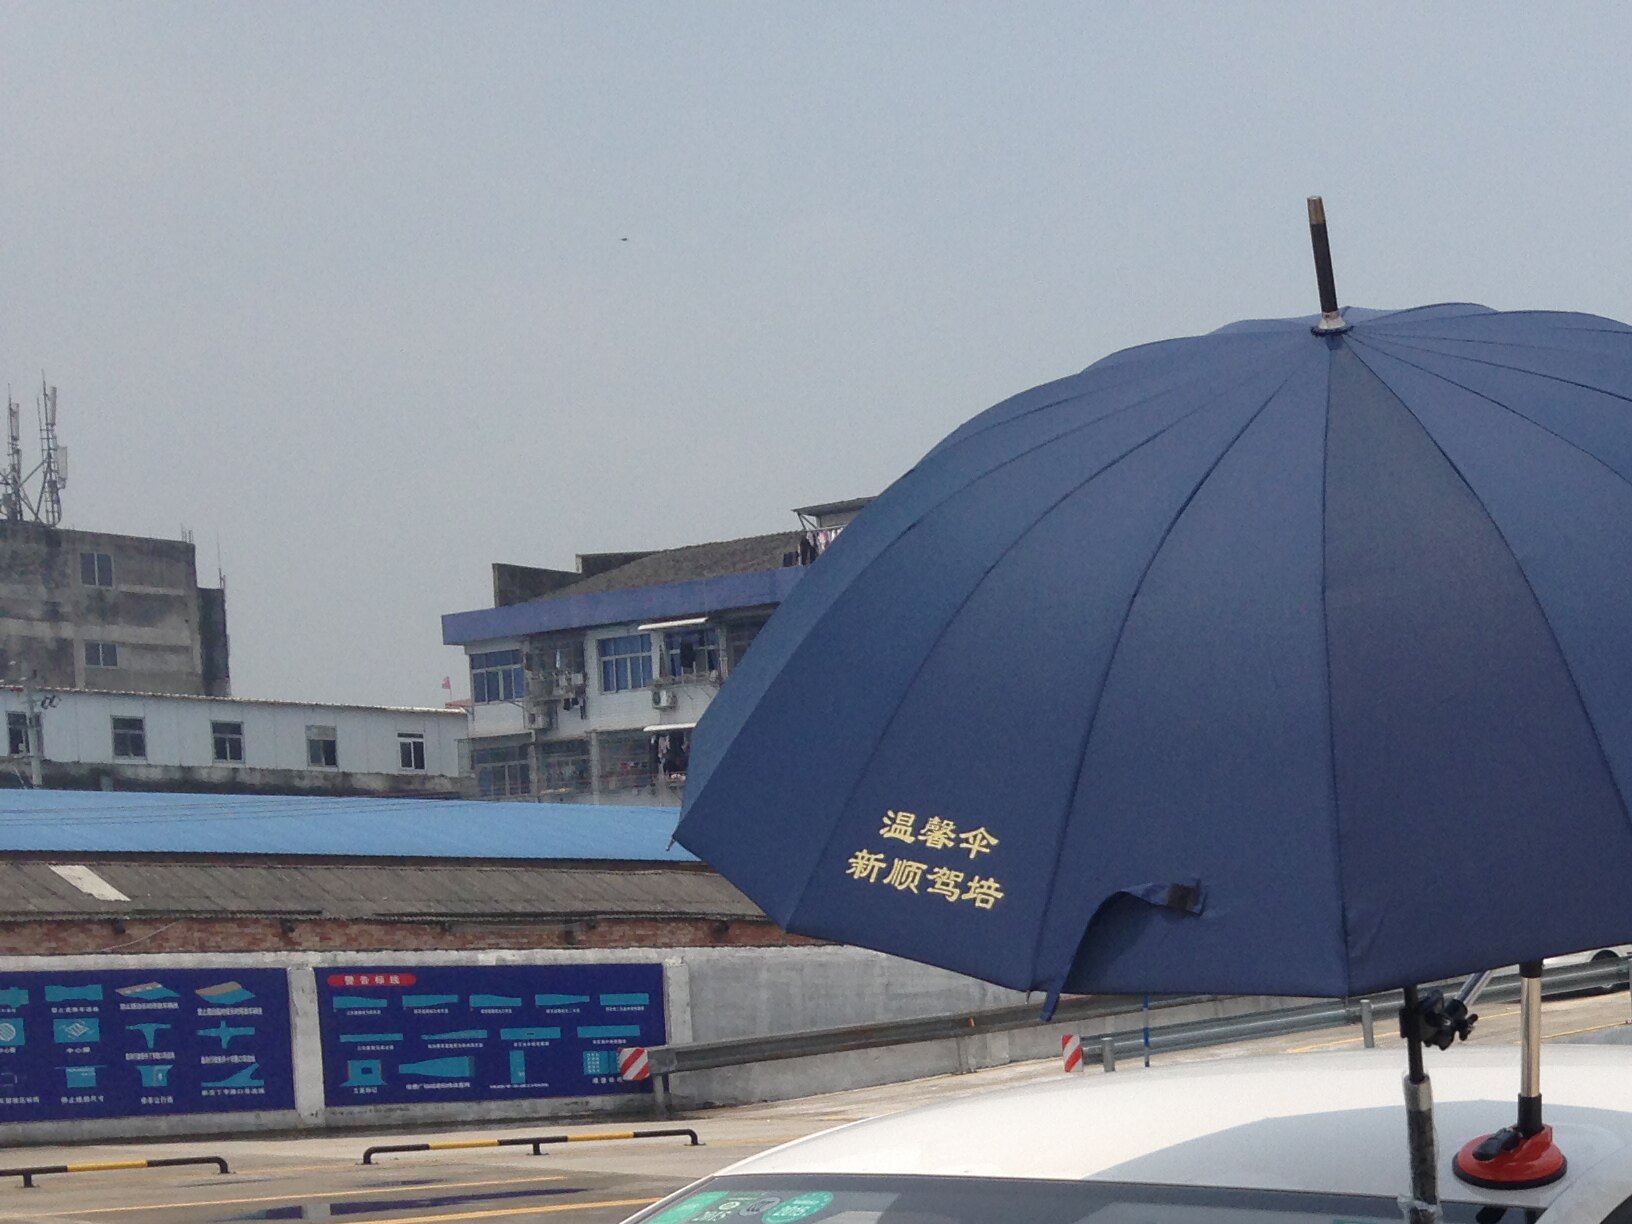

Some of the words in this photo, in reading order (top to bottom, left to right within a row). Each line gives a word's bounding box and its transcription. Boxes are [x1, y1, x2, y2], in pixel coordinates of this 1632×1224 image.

[878, 809, 1000, 859] 温馨伞
[845, 847, 1005, 910] 新顺驾培
